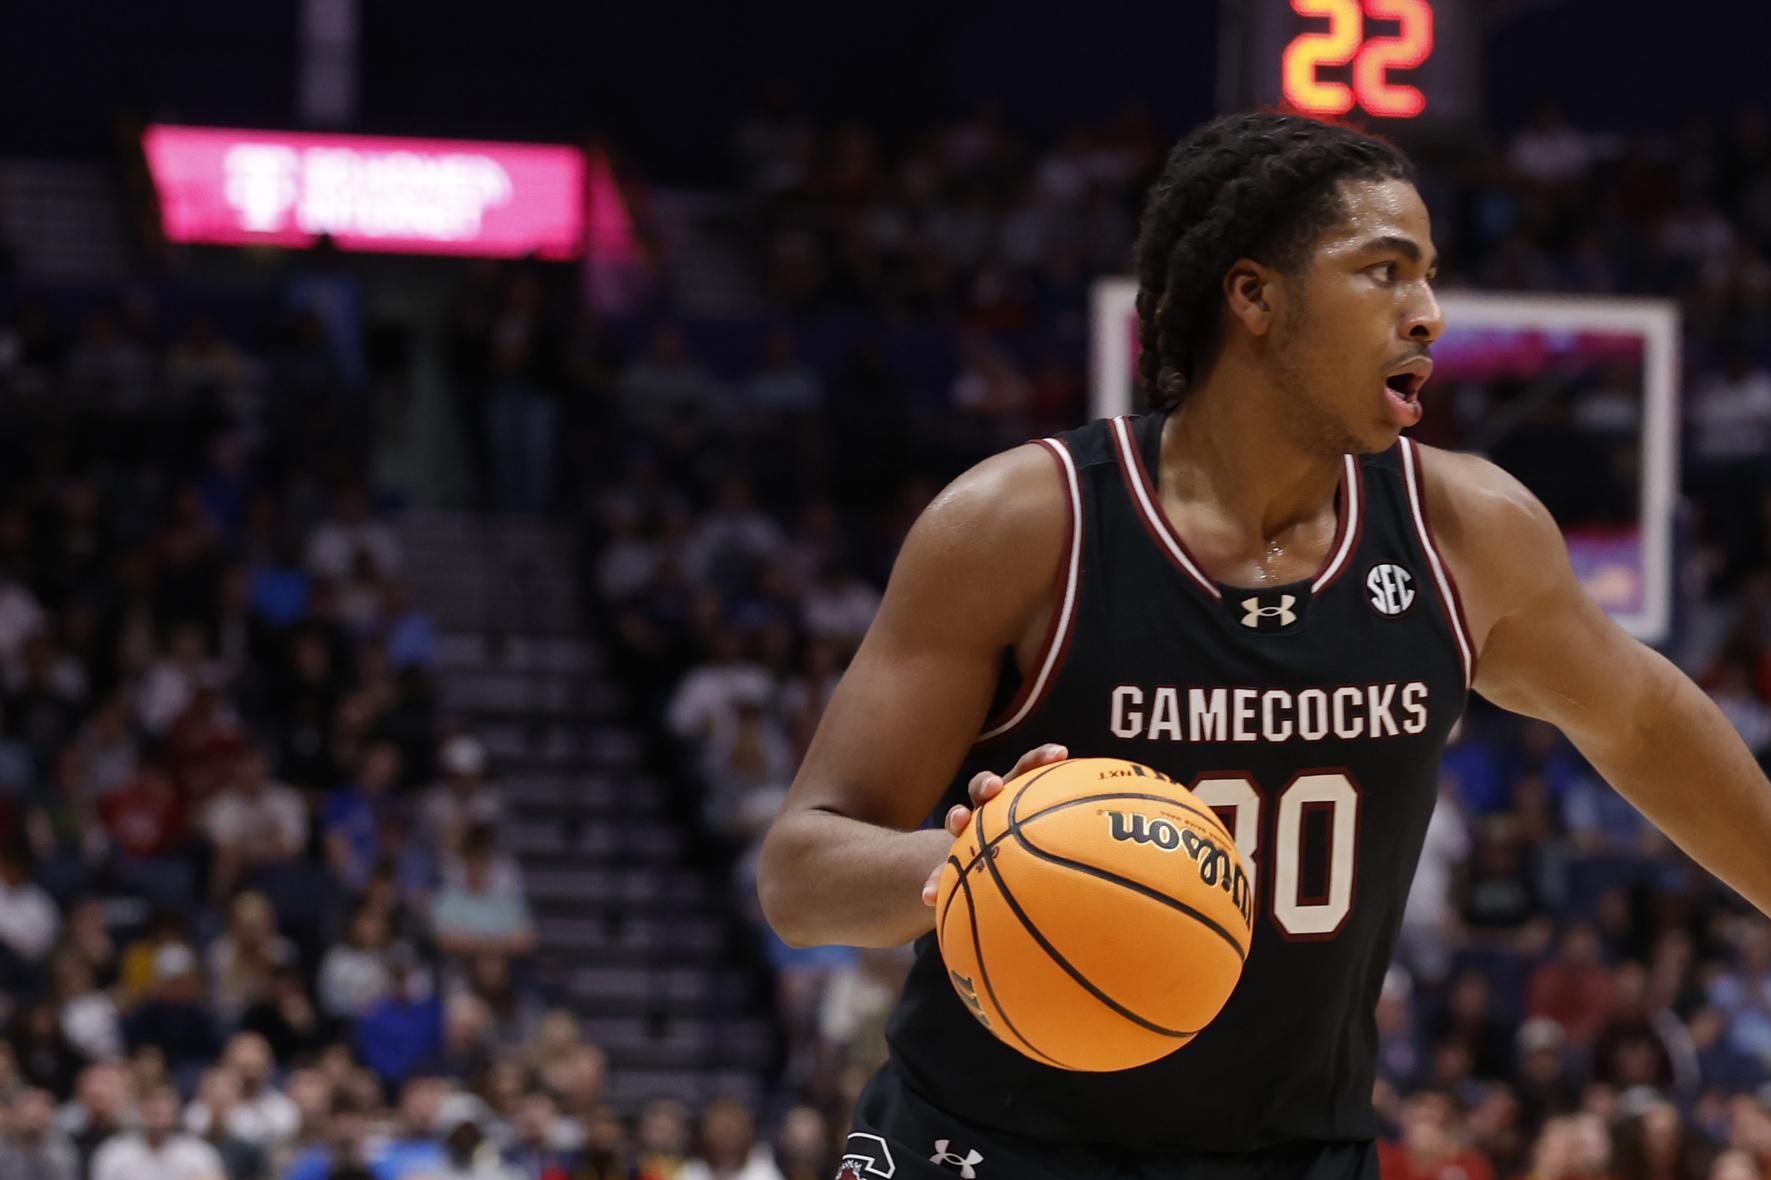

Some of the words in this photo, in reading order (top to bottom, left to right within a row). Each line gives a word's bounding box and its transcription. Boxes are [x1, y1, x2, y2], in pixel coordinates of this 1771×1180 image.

[1282, 0, 1435, 118] 22
[1366, 564, 1416, 615] SEC
[1110, 681, 1429, 742] GAMECOCKS
[1107, 810, 1251, 932] Wilson
